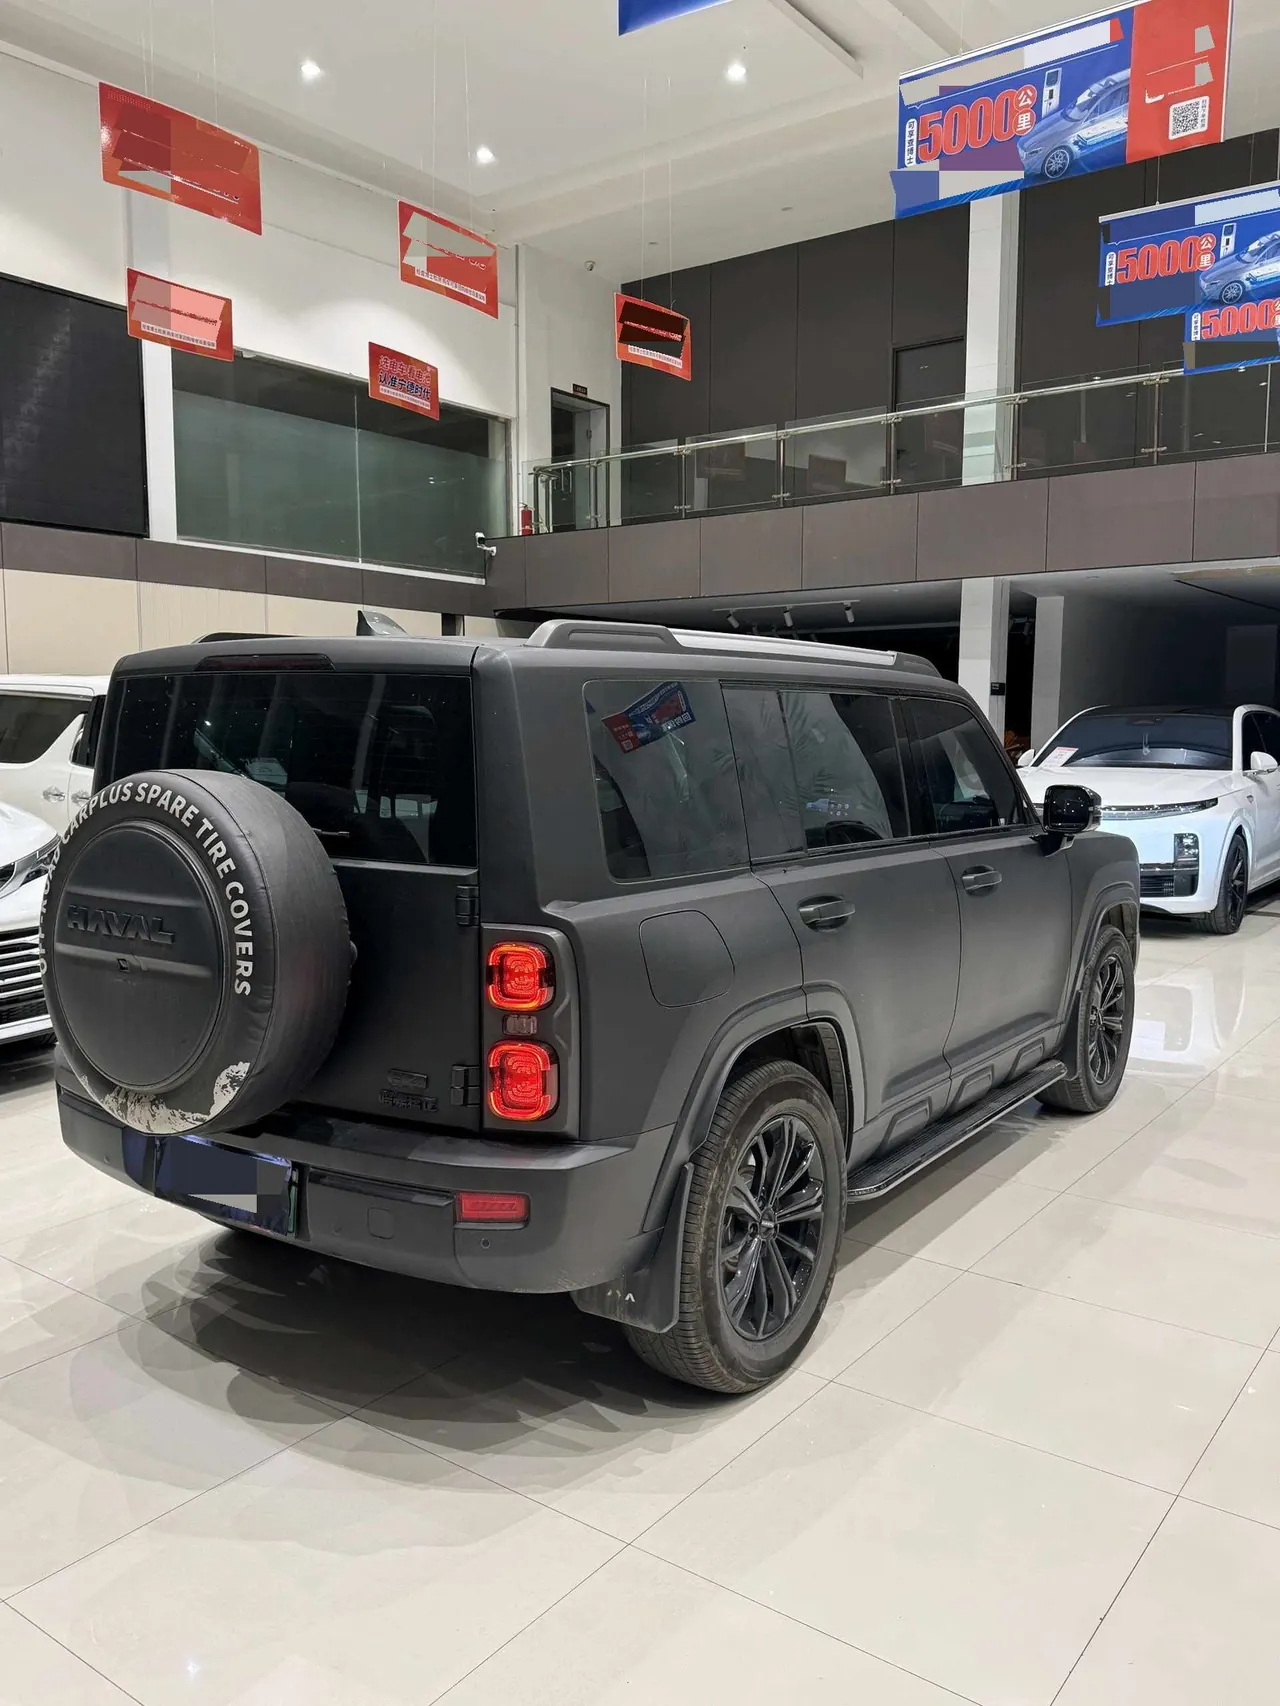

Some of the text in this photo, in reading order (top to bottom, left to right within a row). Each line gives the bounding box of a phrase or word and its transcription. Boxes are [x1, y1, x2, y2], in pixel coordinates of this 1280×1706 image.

[917, 87, 1034, 162] 5000 公里
[1116, 235, 1200, 284] 5000
[1201, 299, 1275, 340] 5000
[134, 781, 200, 828] SPARE
[195, 817, 237, 879] TIRE
[225, 881, 254, 996] COVERS
[66, 904, 176, 945] HAVAL
